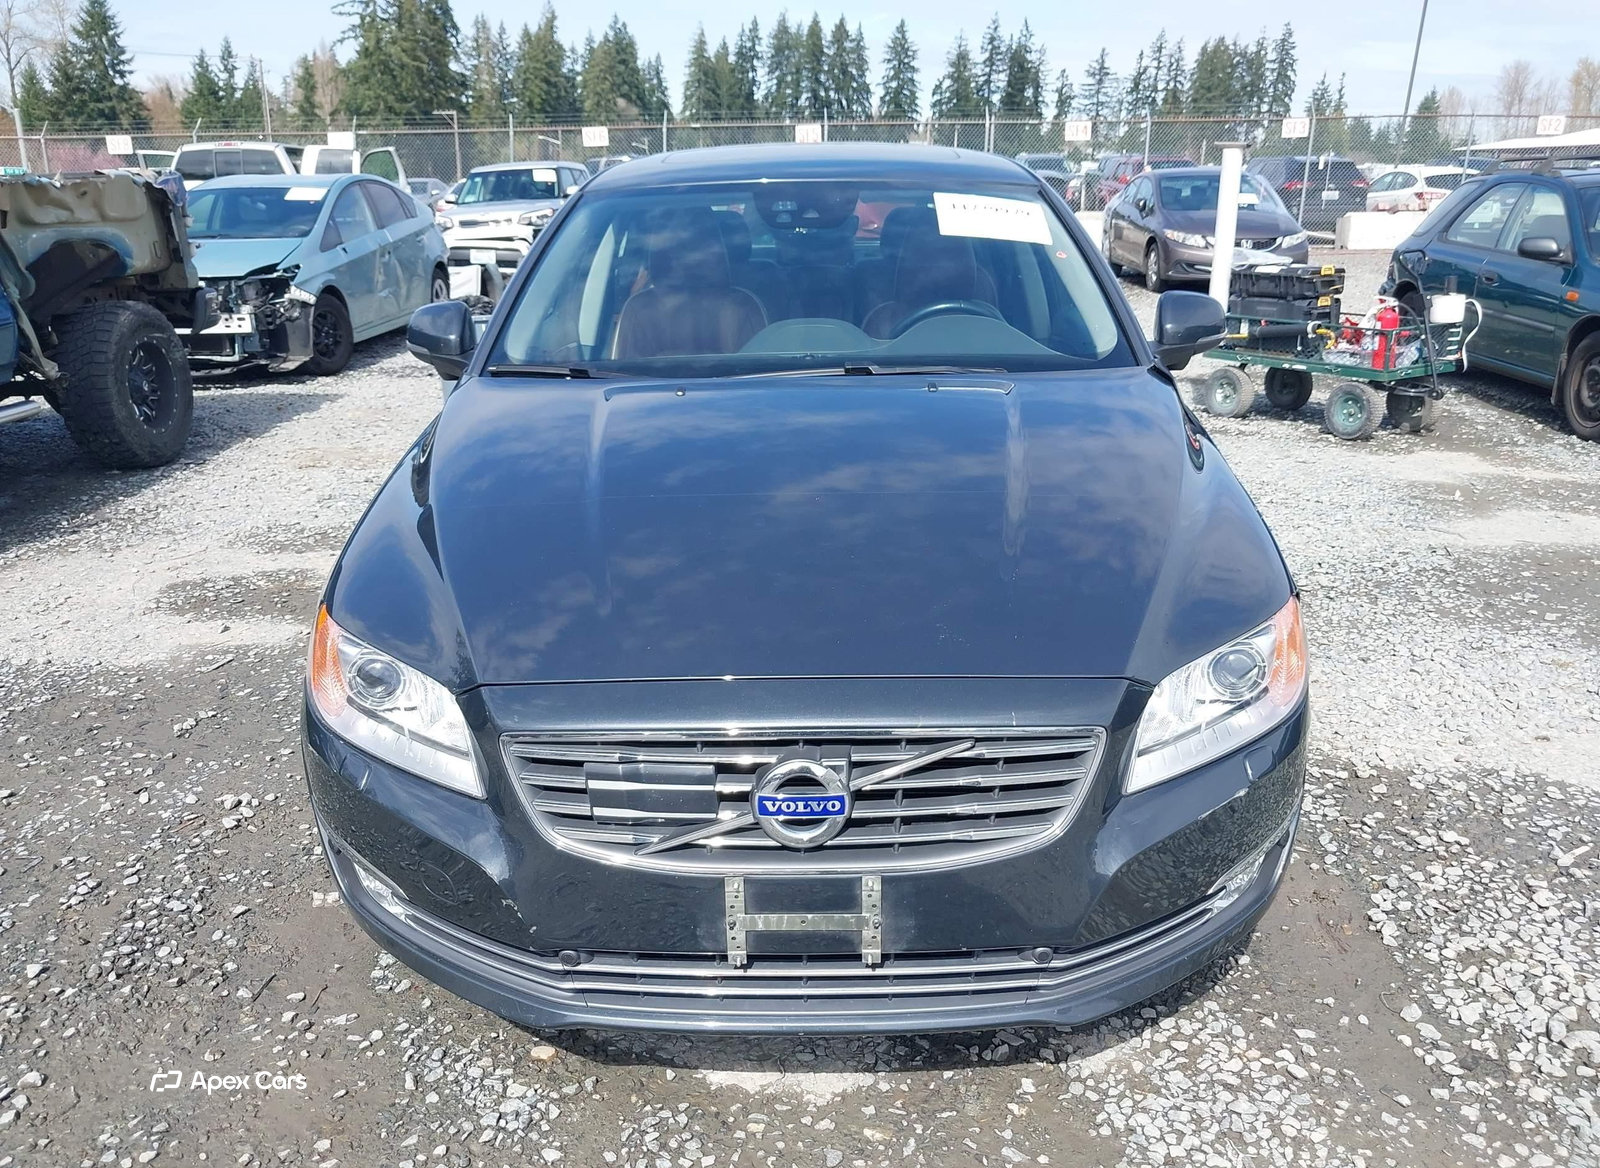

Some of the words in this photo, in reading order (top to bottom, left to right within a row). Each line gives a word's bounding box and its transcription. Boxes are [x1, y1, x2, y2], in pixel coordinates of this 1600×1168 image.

[1068, 124, 1088, 138] SF4
[1285, 121, 1306, 135] SF3
[1540, 118, 1562, 132] SF2
[585, 129, 607, 144] SF6
[762, 800, 841, 813] VOLVO
